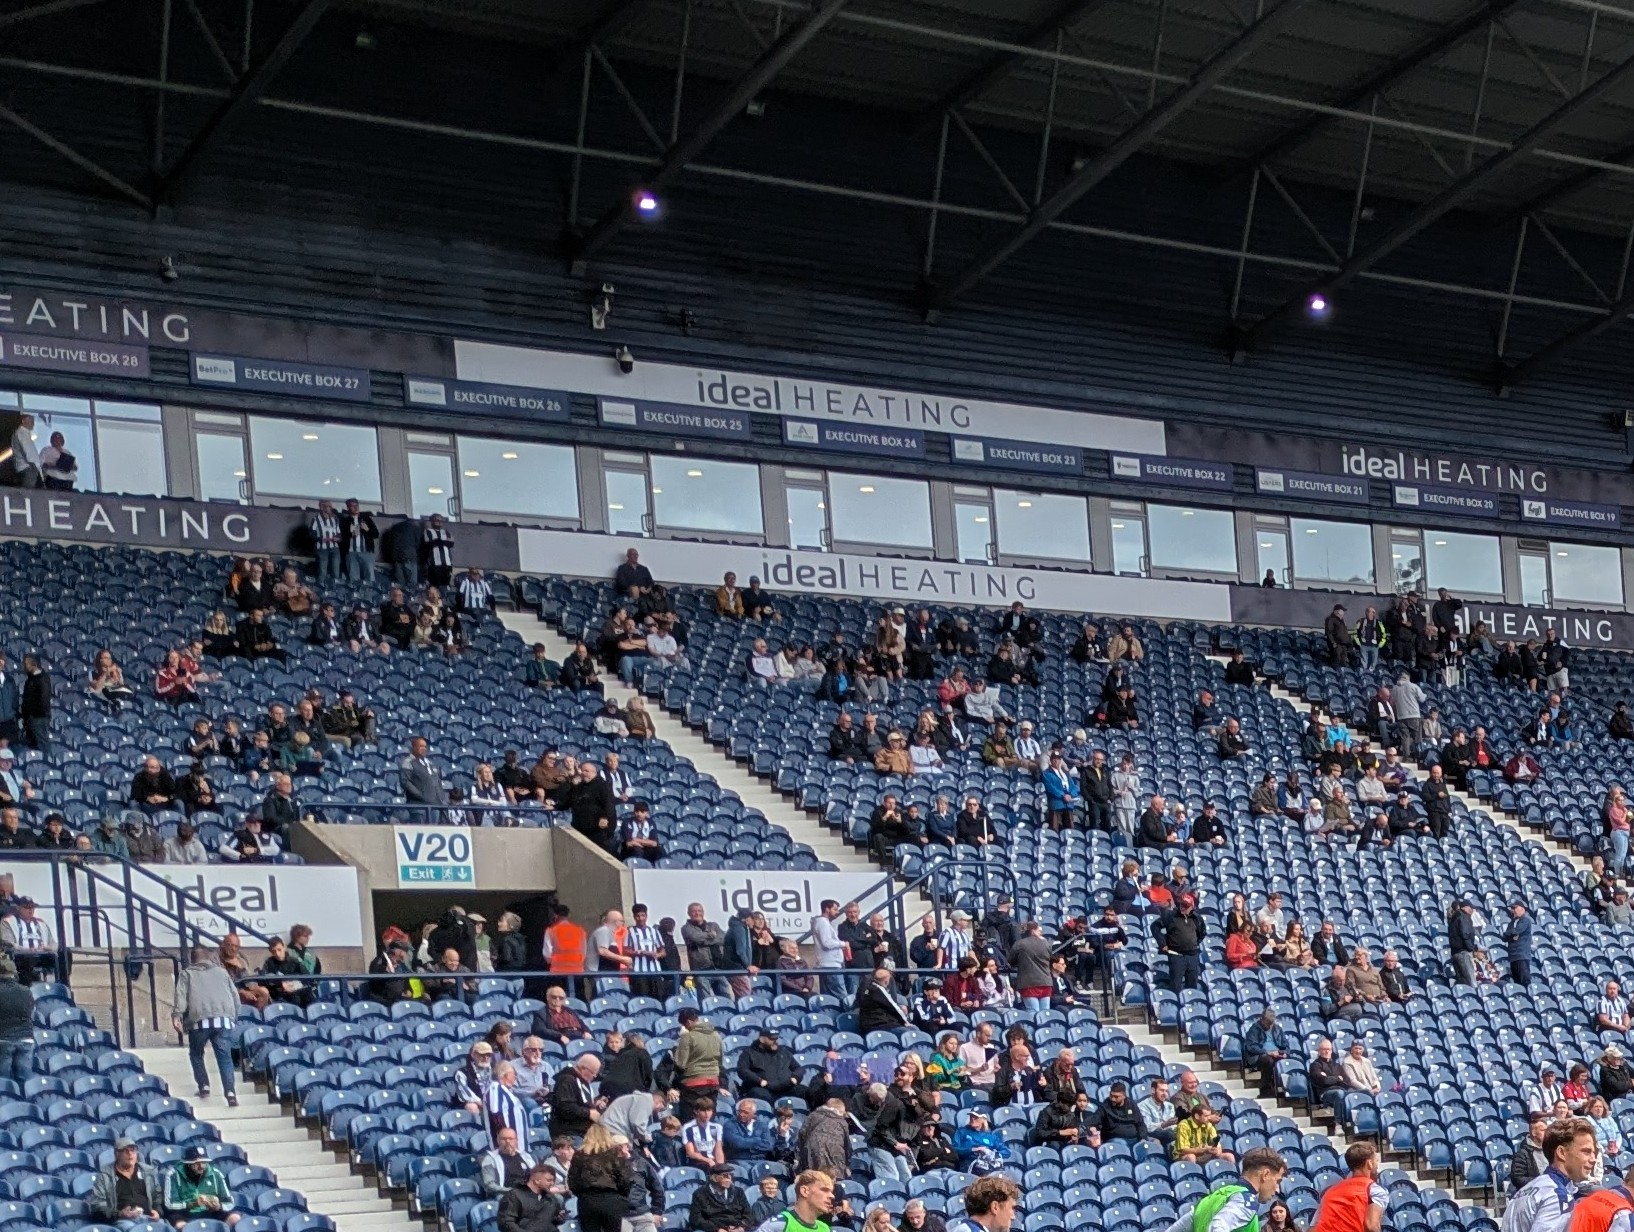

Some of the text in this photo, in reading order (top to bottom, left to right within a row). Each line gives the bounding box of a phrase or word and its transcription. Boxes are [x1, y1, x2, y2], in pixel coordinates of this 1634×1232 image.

[14, 342, 139, 368] EXECUTIVE BOX 28
[244, 367, 359, 389] EXECUTIVE BOX 27
[454, 390, 517, 408] EXECUTIVE
[519, 398, 545, 411] BOX
[546, 401, 561, 412] 26
[697, 372, 971, 428] ideal HEATING
[644, 411, 701, 427] EXECUTIVE
[704, 418, 728, 430] BOX
[729, 421, 742, 431] 25
[825, 430, 878, 445] EXECUTIVE
[881, 437, 903, 448] BOX
[904, 440, 917, 449] 24
[990, 448, 1076, 466] EXECUTIVE BOX 23
[1341, 445, 1548, 493] ideal HEATING
[1146, 464, 1194, 478] EXECUTIVE
[1195, 470, 1214, 480] BOX
[1214, 472, 1226, 481] 22
[1289, 479, 1363, 495] EXECUTIVE BOX 21
[3, 496, 250, 542] HEATING
[762, 553, 1036, 600] ideal HEATING
[398, 832, 470, 862] V20
[408, 867, 435, 880] Exit
[164, 874, 278, 912] ideal
[720, 878, 812, 913] ideal
